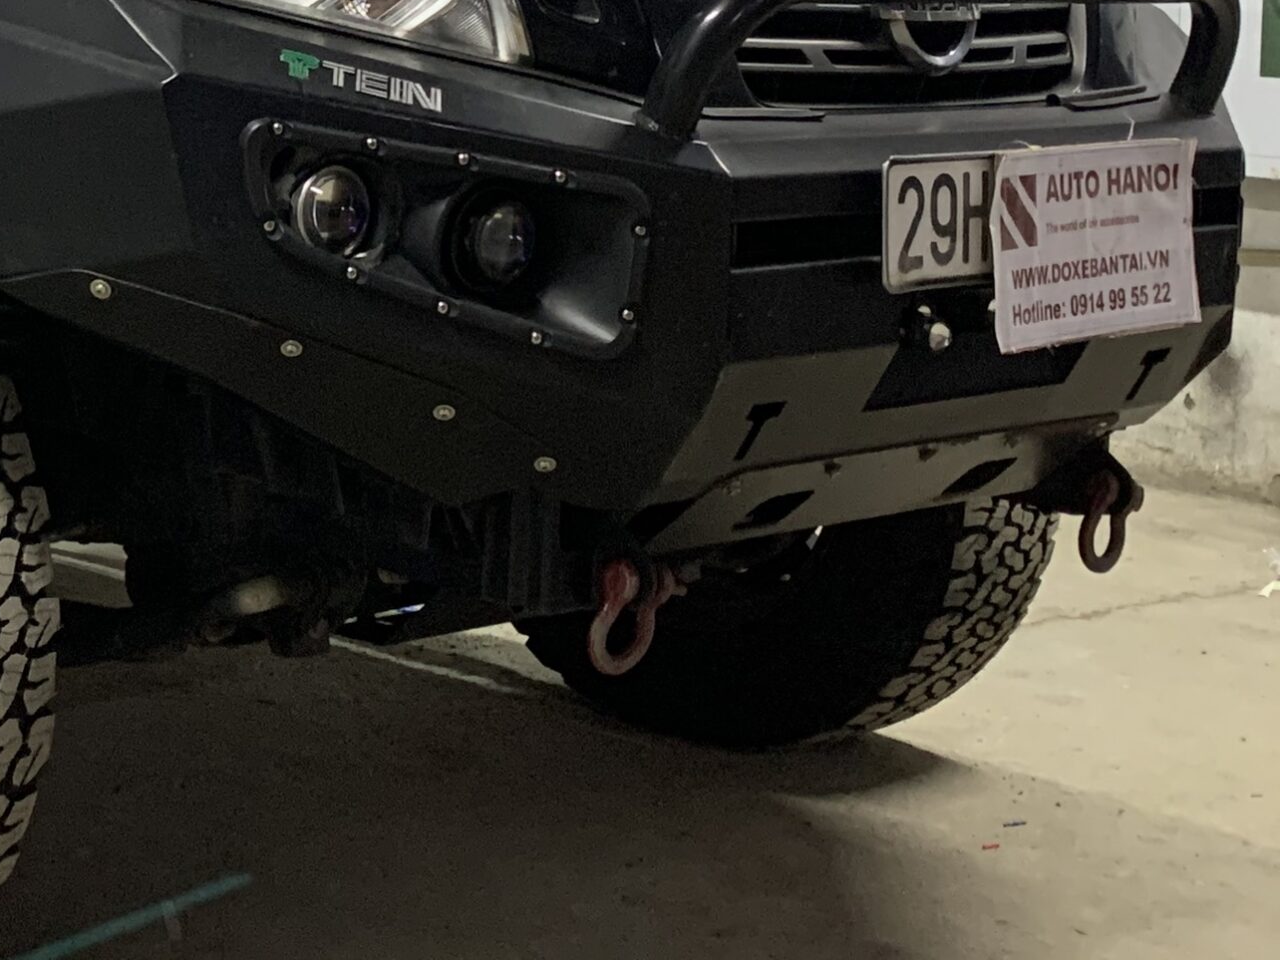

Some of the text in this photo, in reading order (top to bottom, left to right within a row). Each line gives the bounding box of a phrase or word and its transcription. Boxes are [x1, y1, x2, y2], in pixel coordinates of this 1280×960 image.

[322, 59, 443, 114] TEIN
[1046, 163, 1179, 203] AUTO HANOI
[897, 170, 990, 275] 29H
[1011, 249, 1170, 290] WWW.DOXEBANTAI.VN
[1012, 282, 1172, 327] Hotline: 0914 99 55 22
